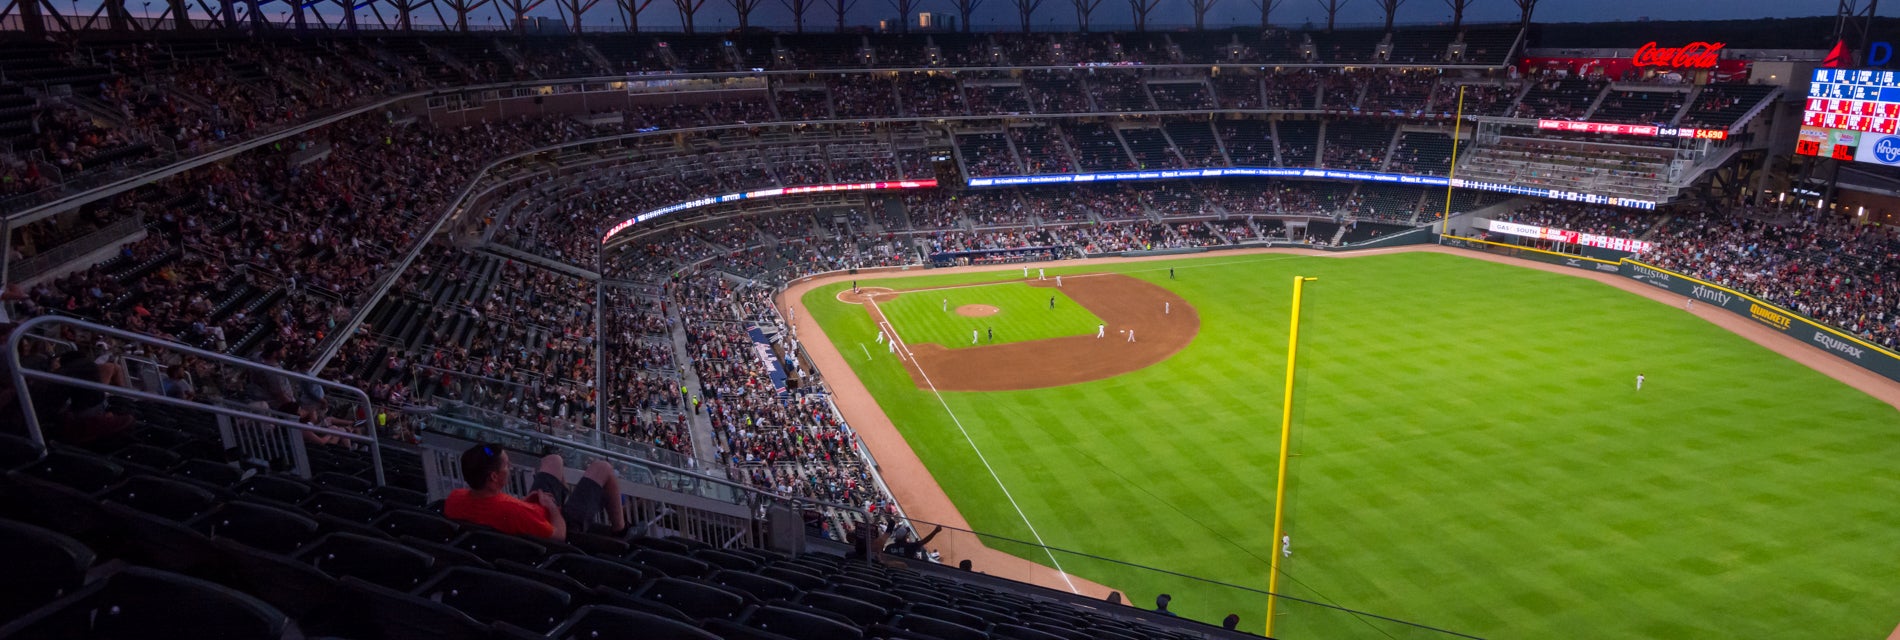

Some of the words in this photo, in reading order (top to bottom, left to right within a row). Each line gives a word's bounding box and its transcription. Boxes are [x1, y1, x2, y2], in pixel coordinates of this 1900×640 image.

[1867, 41, 1893, 66] D
[1816, 70, 1828, 81] NL
[1810, 100, 1821, 111] AL
[1691, 284, 1731, 306] xfinity
[1750, 303, 1791, 327] QUIKRETE
[1814, 331, 1865, 359] EQUIFAX
